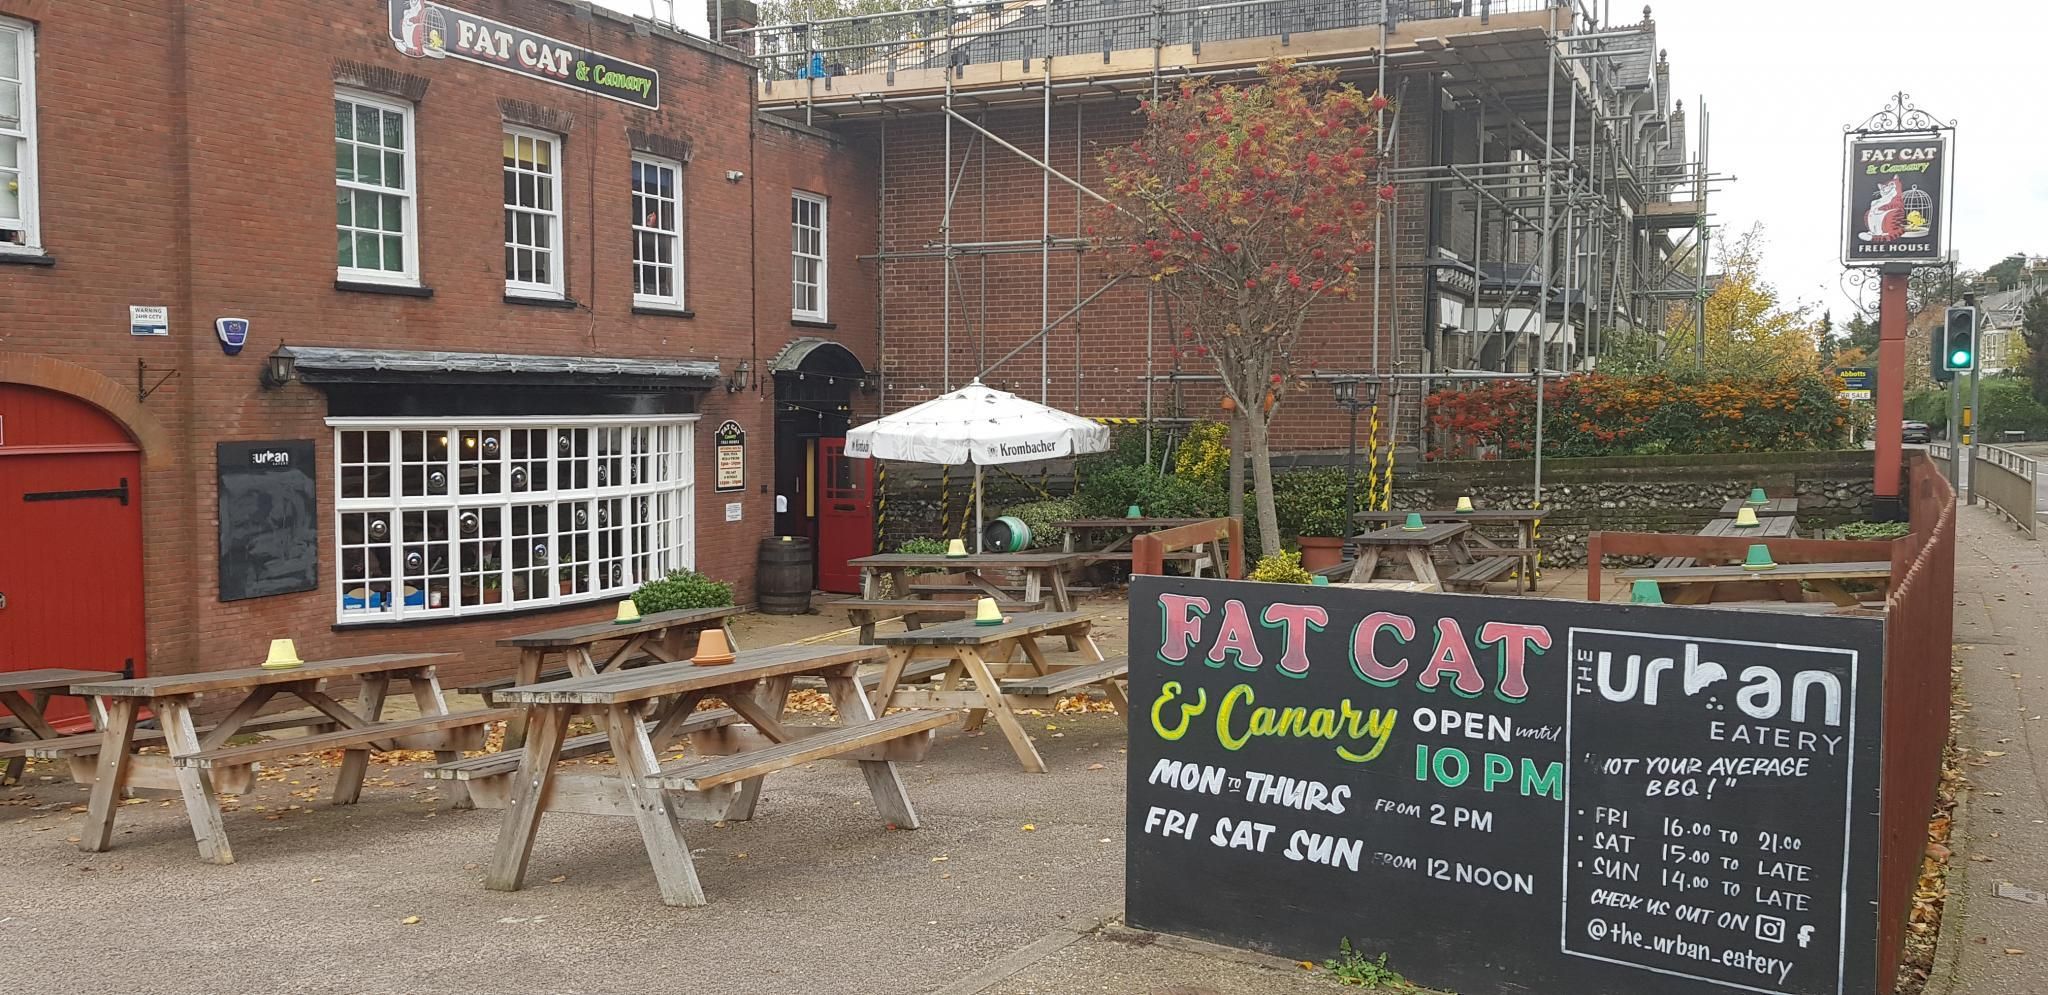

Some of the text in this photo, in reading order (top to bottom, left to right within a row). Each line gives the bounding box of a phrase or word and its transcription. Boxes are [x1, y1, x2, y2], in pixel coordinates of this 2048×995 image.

[456, 19, 652, 99] FAT CAT & Canary
[1861, 147, 1937, 162] FAT CAT
[1866, 162, 1930, 175] & Canary
[1858, 243, 1931, 253] FREE HOUSE
[255, 450, 289, 464] urban
[1000, 440, 1057, 457] Krombacher
[1157, 593, 1552, 704] FAT CAT
[1576, 648, 1593, 696] THE
[1597, 643, 1842, 727] urban
[1151, 681, 1398, 763] & Canary
[1413, 707, 1562, 743] OPEN until
[1710, 721, 1843, 756] EATERY
[1148, 758, 1352, 815] MON TO THURS
[1416, 743, 1564, 801] 10 PM
[1646, 756, 1702, 775] YOUR
[1707, 757, 1810, 778] AVERAGE
[1144, 805, 1364, 872] FRI SAT SUN
[1374, 798, 1493, 833] FROM 2 PM
[1595, 807, 1802, 853] FRI 16.00 TO 21.00
[1373, 850, 1534, 895] FROM 12 NOON
[1593, 832, 1813, 882] SAT 15.00 TO LATE
[1592, 857, 1812, 912] SUN 14.00 TO LATE
[1590, 888, 1644, 910] CHECK
[1646, 898, 1671, 916] US
[1675, 904, 1714, 927] OUT
[1717, 912, 1750, 932] ON
[1587, 917, 1794, 986] @the_urban_eatery
